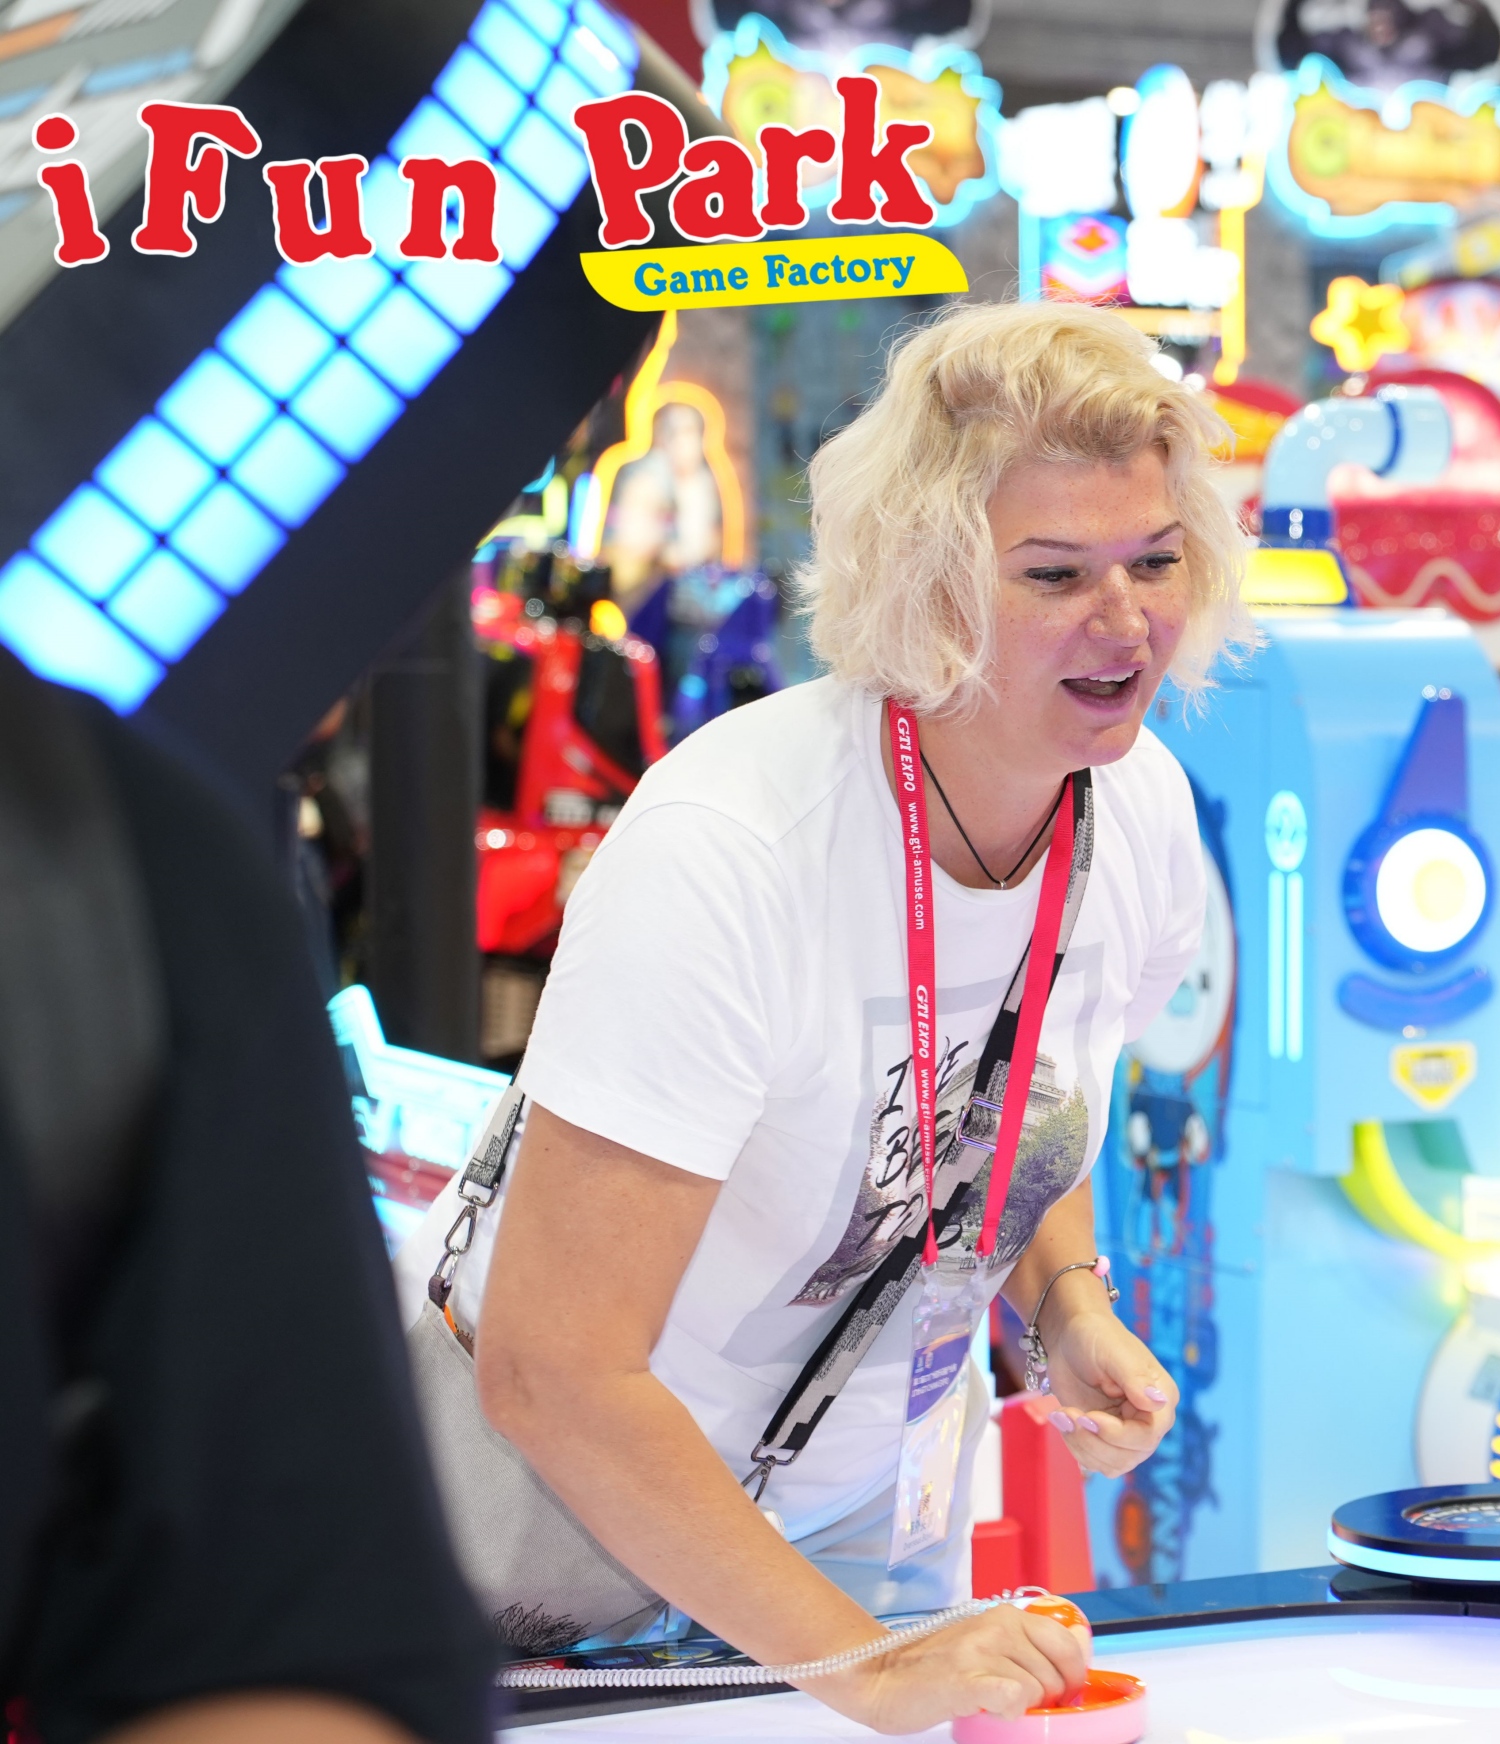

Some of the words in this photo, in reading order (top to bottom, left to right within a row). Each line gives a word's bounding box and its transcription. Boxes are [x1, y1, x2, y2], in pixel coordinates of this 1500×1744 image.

[897, 717, 911, 752] GTI
[900, 754, 916, 792] EXPO
[908, 801, 924, 931] www.gti-amuse.com
[916, 984, 929, 1020] GTI
[917, 1020, 929, 1059] EXPO
